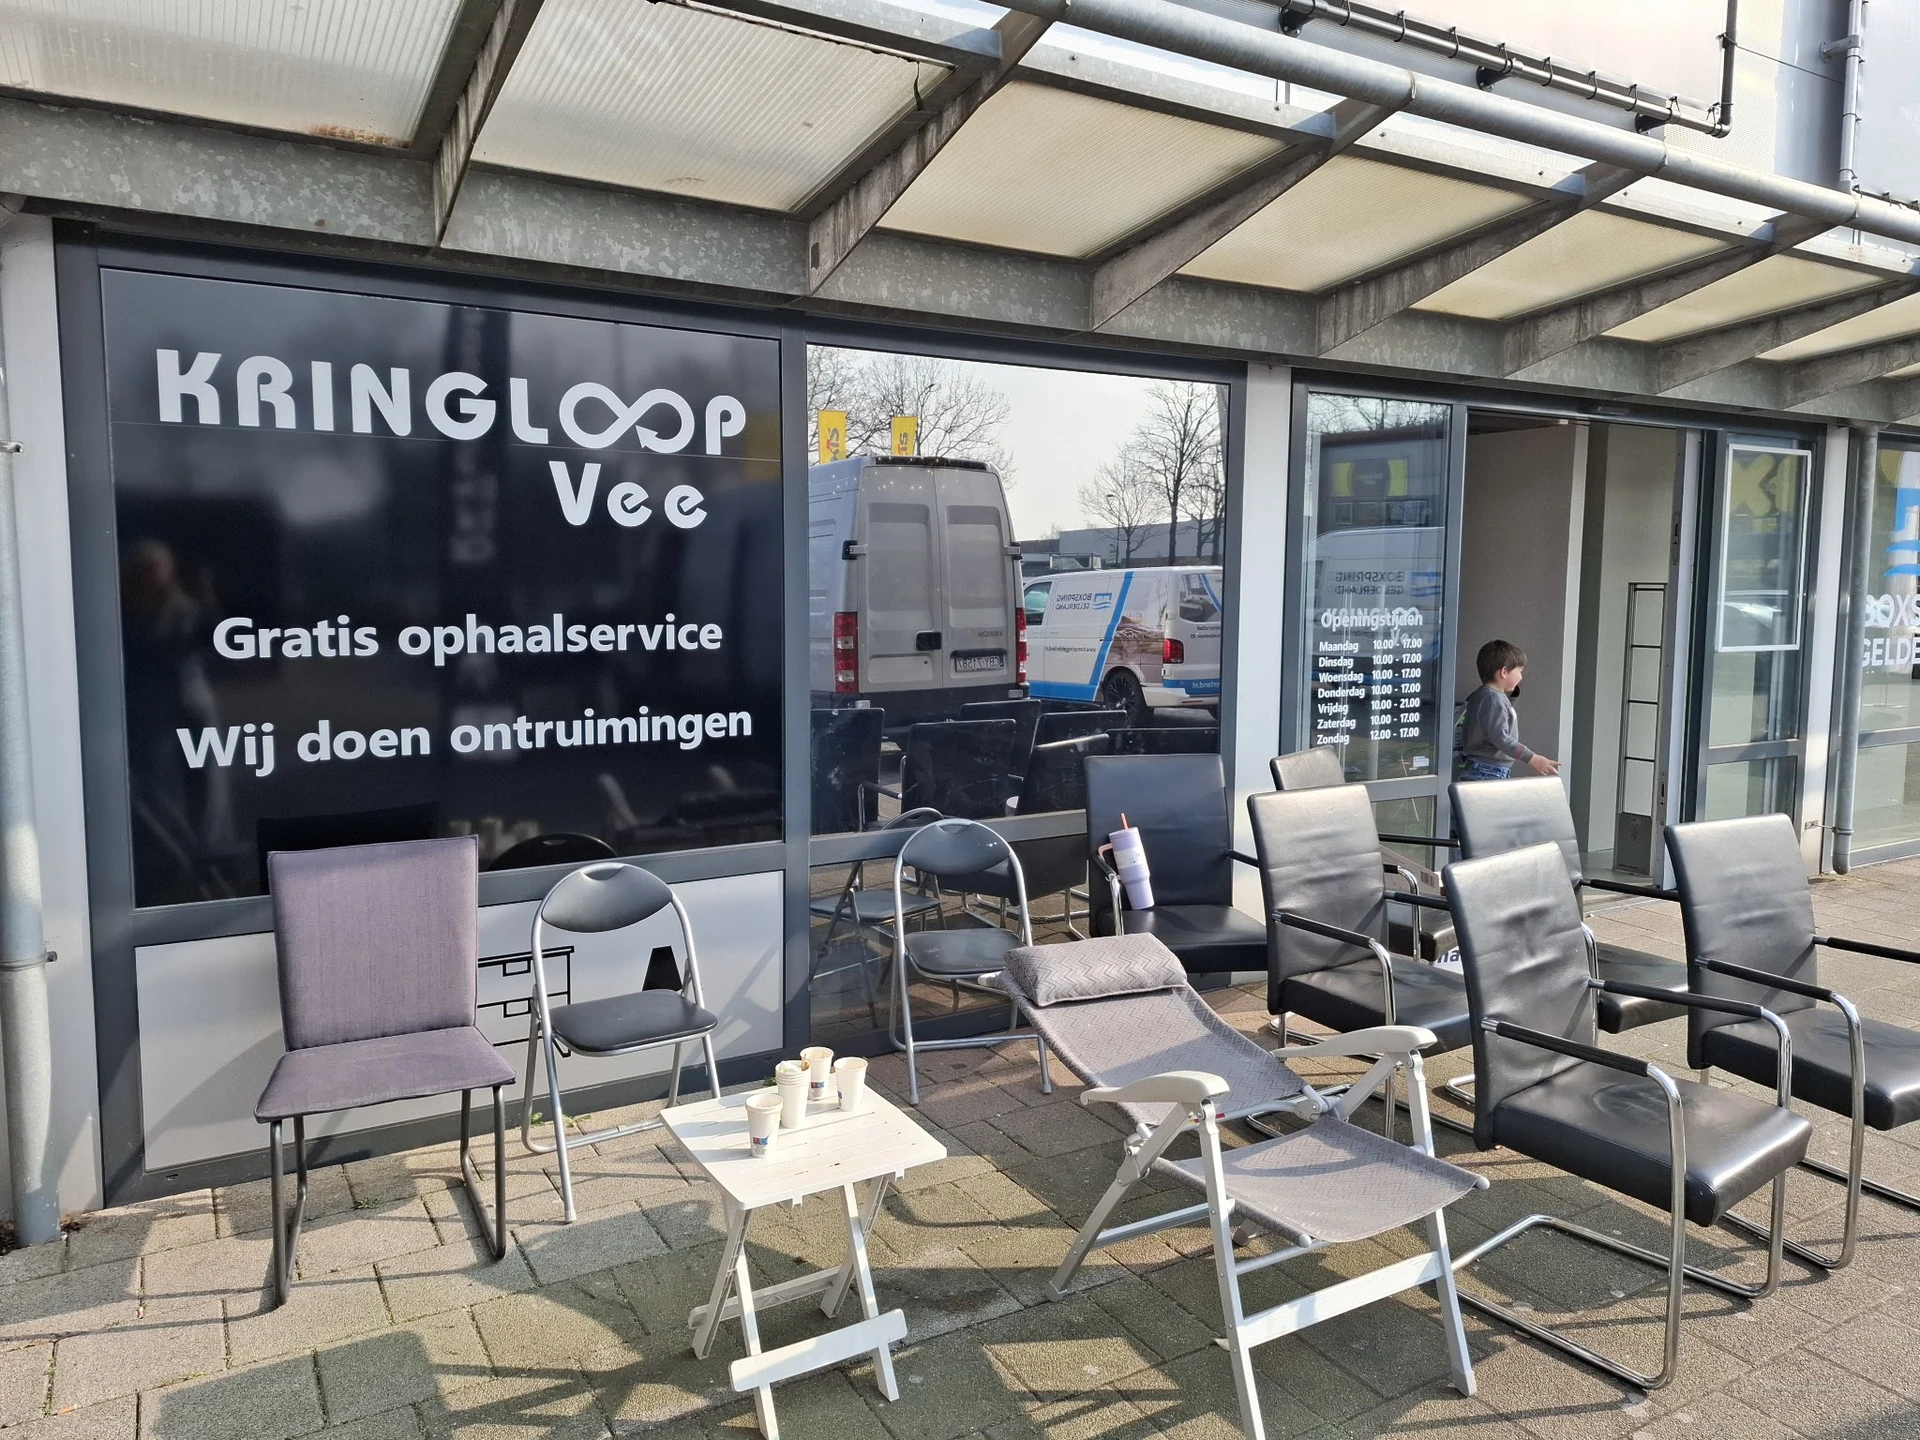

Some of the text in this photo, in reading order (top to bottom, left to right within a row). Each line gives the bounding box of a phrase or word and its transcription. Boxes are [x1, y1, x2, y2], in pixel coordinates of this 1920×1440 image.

[156, 348, 746, 456] KRINGLOOP
[548, 460, 708, 529] Vee
[1321, 610, 1423, 631] Openingstijden
[213, 613, 723, 667] Gratis ophaalservice
[1319, 641, 1359, 653] Maandag
[1373, 639, 1393, 649] 10.00
[1403, 638, 1422, 648] 17.00
[1318, 656, 1354, 668] Dinsdag
[1372, 654, 1393, 665] 10.00
[1402, 653, 1422, 663] 17.00
[1318, 672, 1364, 684] Woensdag
[1372, 669, 1393, 680] 10.00
[1401, 668, 1421, 678] 17.00
[1317, 687, 1365, 699] Donderdag
[1371, 685, 1392, 695] 10.00
[1401, 683, 1421, 693] 17.00
[1318, 703, 1349, 716] Vrijdag
[1371, 699, 1392, 710] 10.00
[1400, 698, 1420, 708] 21.00
[1317, 718, 1356, 730] Zaterdag
[1370, 715, 1391, 725] 10.00
[1400, 712, 1420, 723] 17.00
[176, 705, 752, 777] Wij doen ontruimingen
[1317, 734, 1350, 745] Zondag
[1370, 729, 1391, 740] 12.00
[1399, 727, 1419, 738] 17.00
